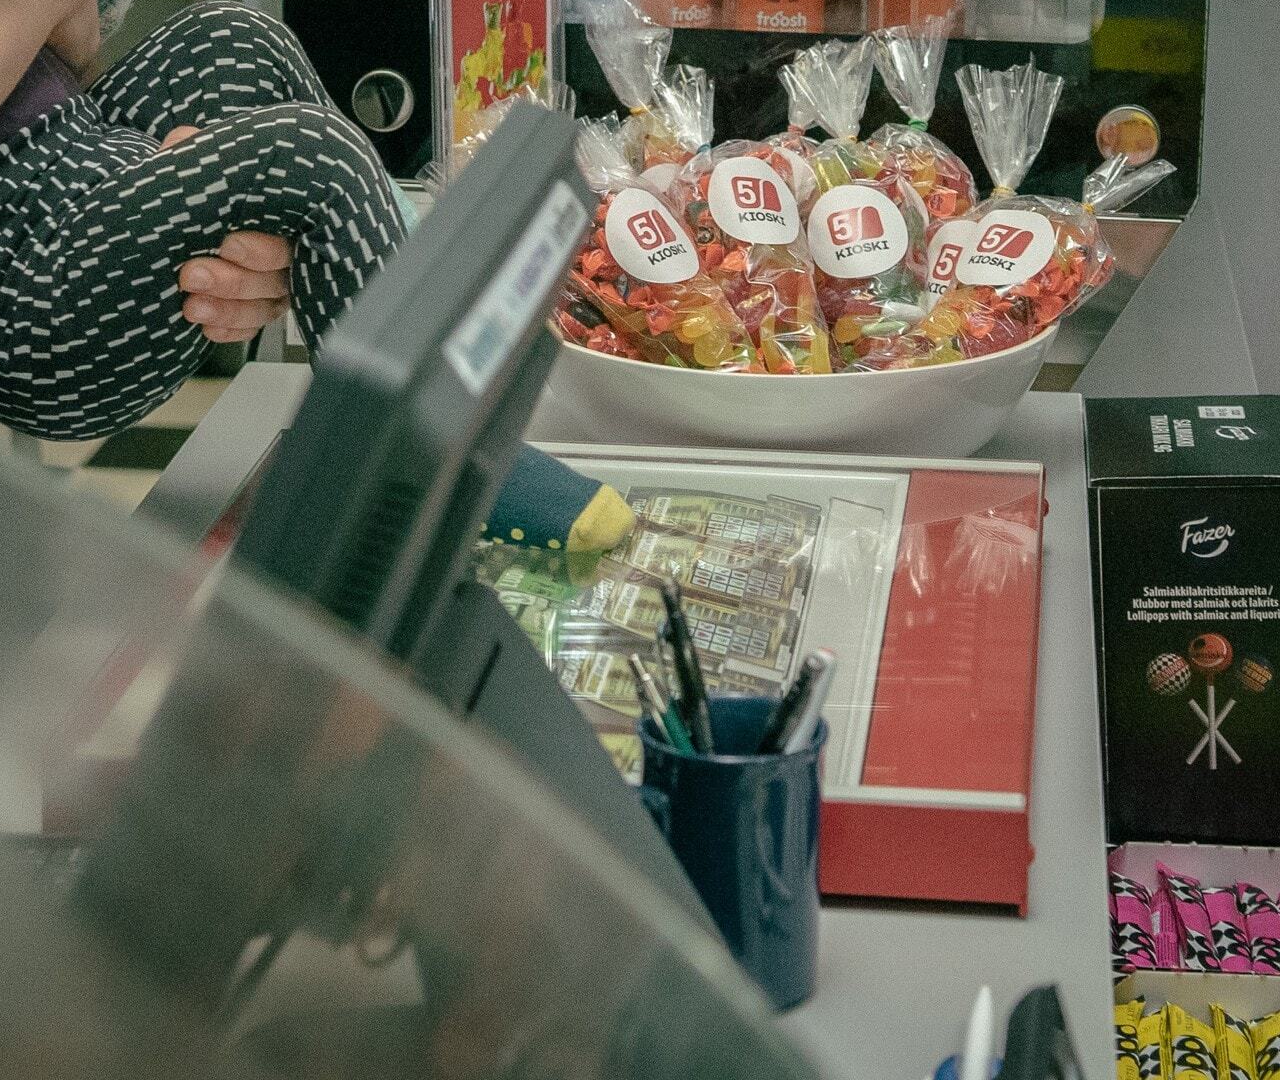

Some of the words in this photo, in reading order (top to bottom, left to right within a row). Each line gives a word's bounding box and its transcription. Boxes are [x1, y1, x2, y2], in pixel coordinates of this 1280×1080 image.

[737, 180, 757, 205] 5
[738, 211, 786, 227] KIOSKI
[832, 215, 850, 241] 5
[633, 216, 658, 245] 5
[980, 227, 1009, 250] 5
[647, 243, 688, 266] KIOSKI
[835, 239, 890, 261] KIOSKI
[935, 247, 958, 277] 5
[968, 254, 1016, 272] KIOSKI
[927, 281, 948, 296] KIO
[1180, 516, 1236, 554] Fazer
[1143, 585, 1267, 597] Salmiakkilakritsitikkareita
[1132, 598, 1170, 609] Klubbor
[1171, 598, 1192, 609] med
[1193, 598, 1230, 609] salmiak
[1249, 597, 1279, 608] lakrits
[1127, 610, 1169, 623] Lollipops
[1170, 610, 1192, 621] with
[1193, 610, 1229, 620] salmiac
[1230, 610, 1249, 620] and
